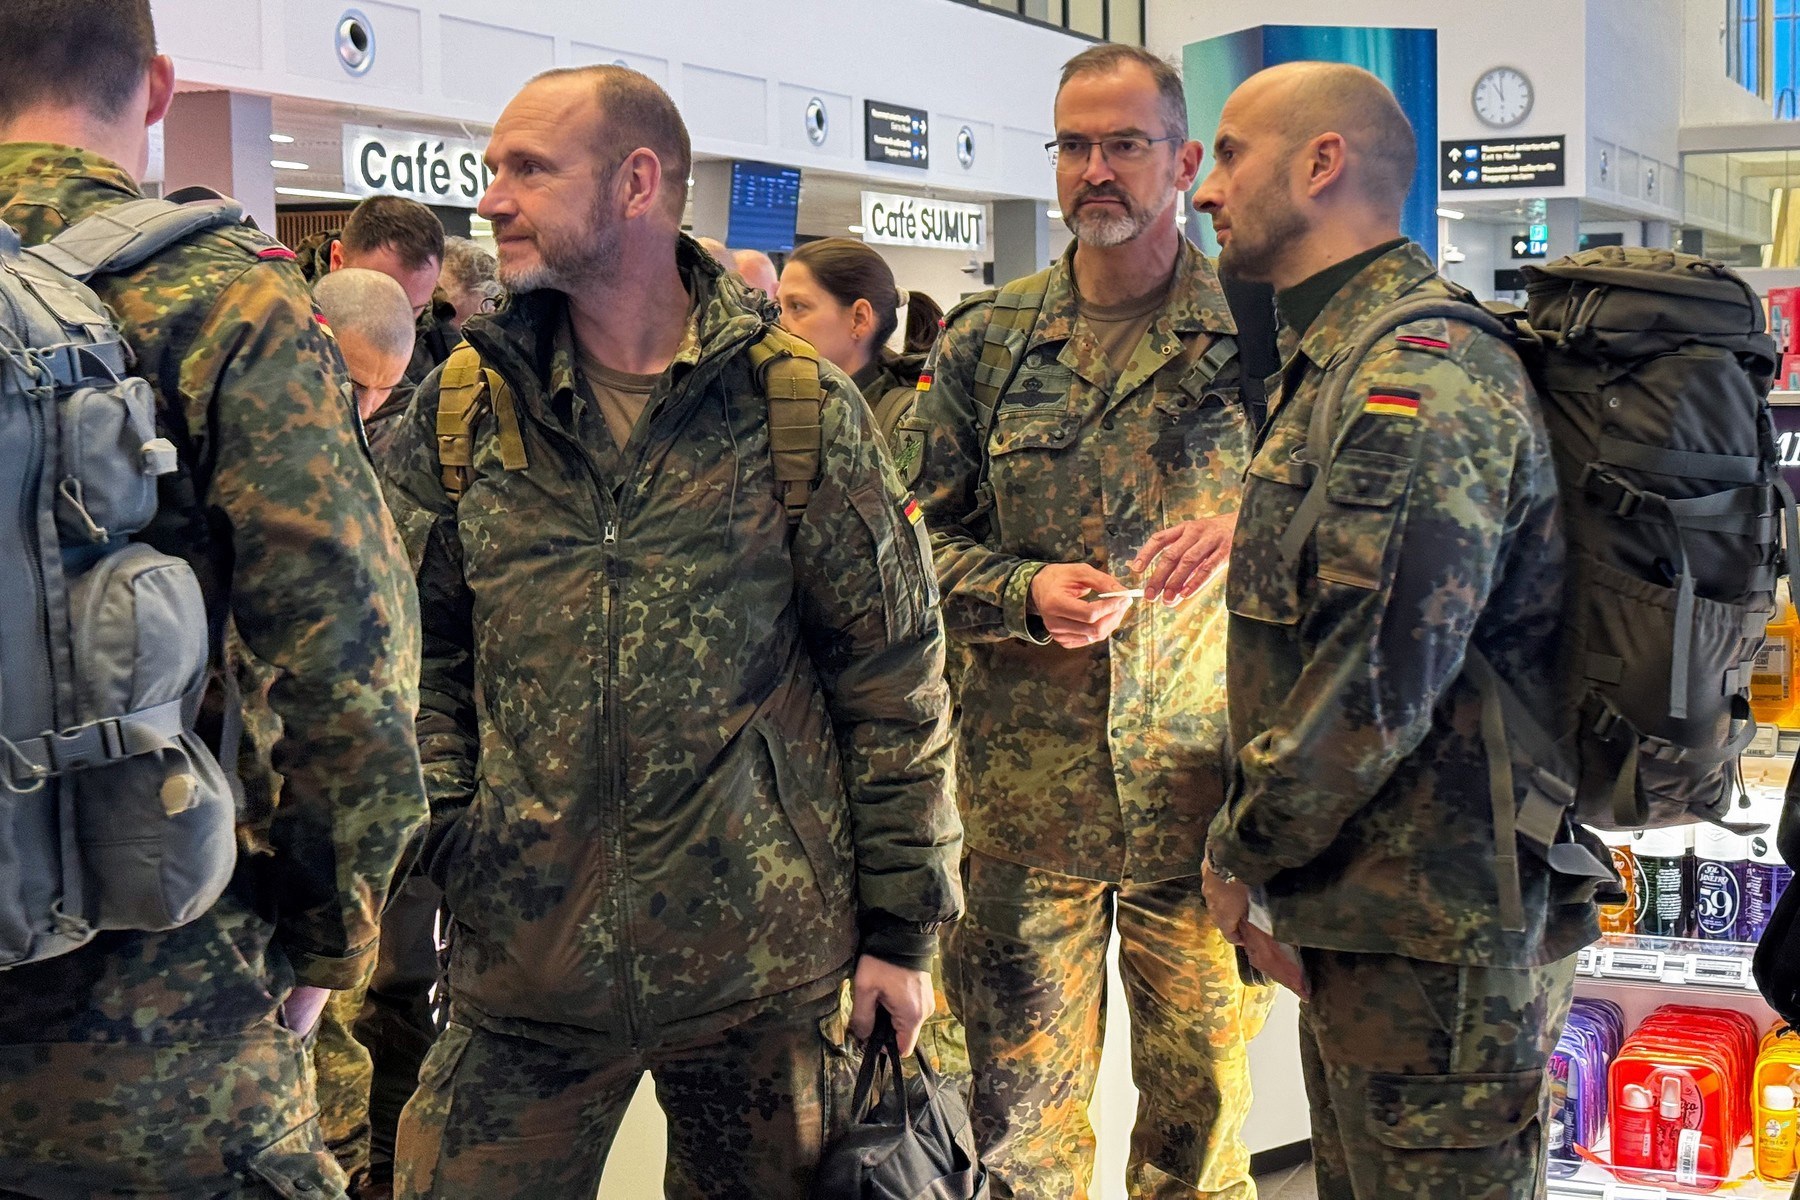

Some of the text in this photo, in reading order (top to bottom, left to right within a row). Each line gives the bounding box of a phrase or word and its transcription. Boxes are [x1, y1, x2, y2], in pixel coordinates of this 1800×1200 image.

[360, 141, 451, 195] Café
[872, 200, 983, 245] Café SUMUT
[1698, 887, 1733, 919] 59
